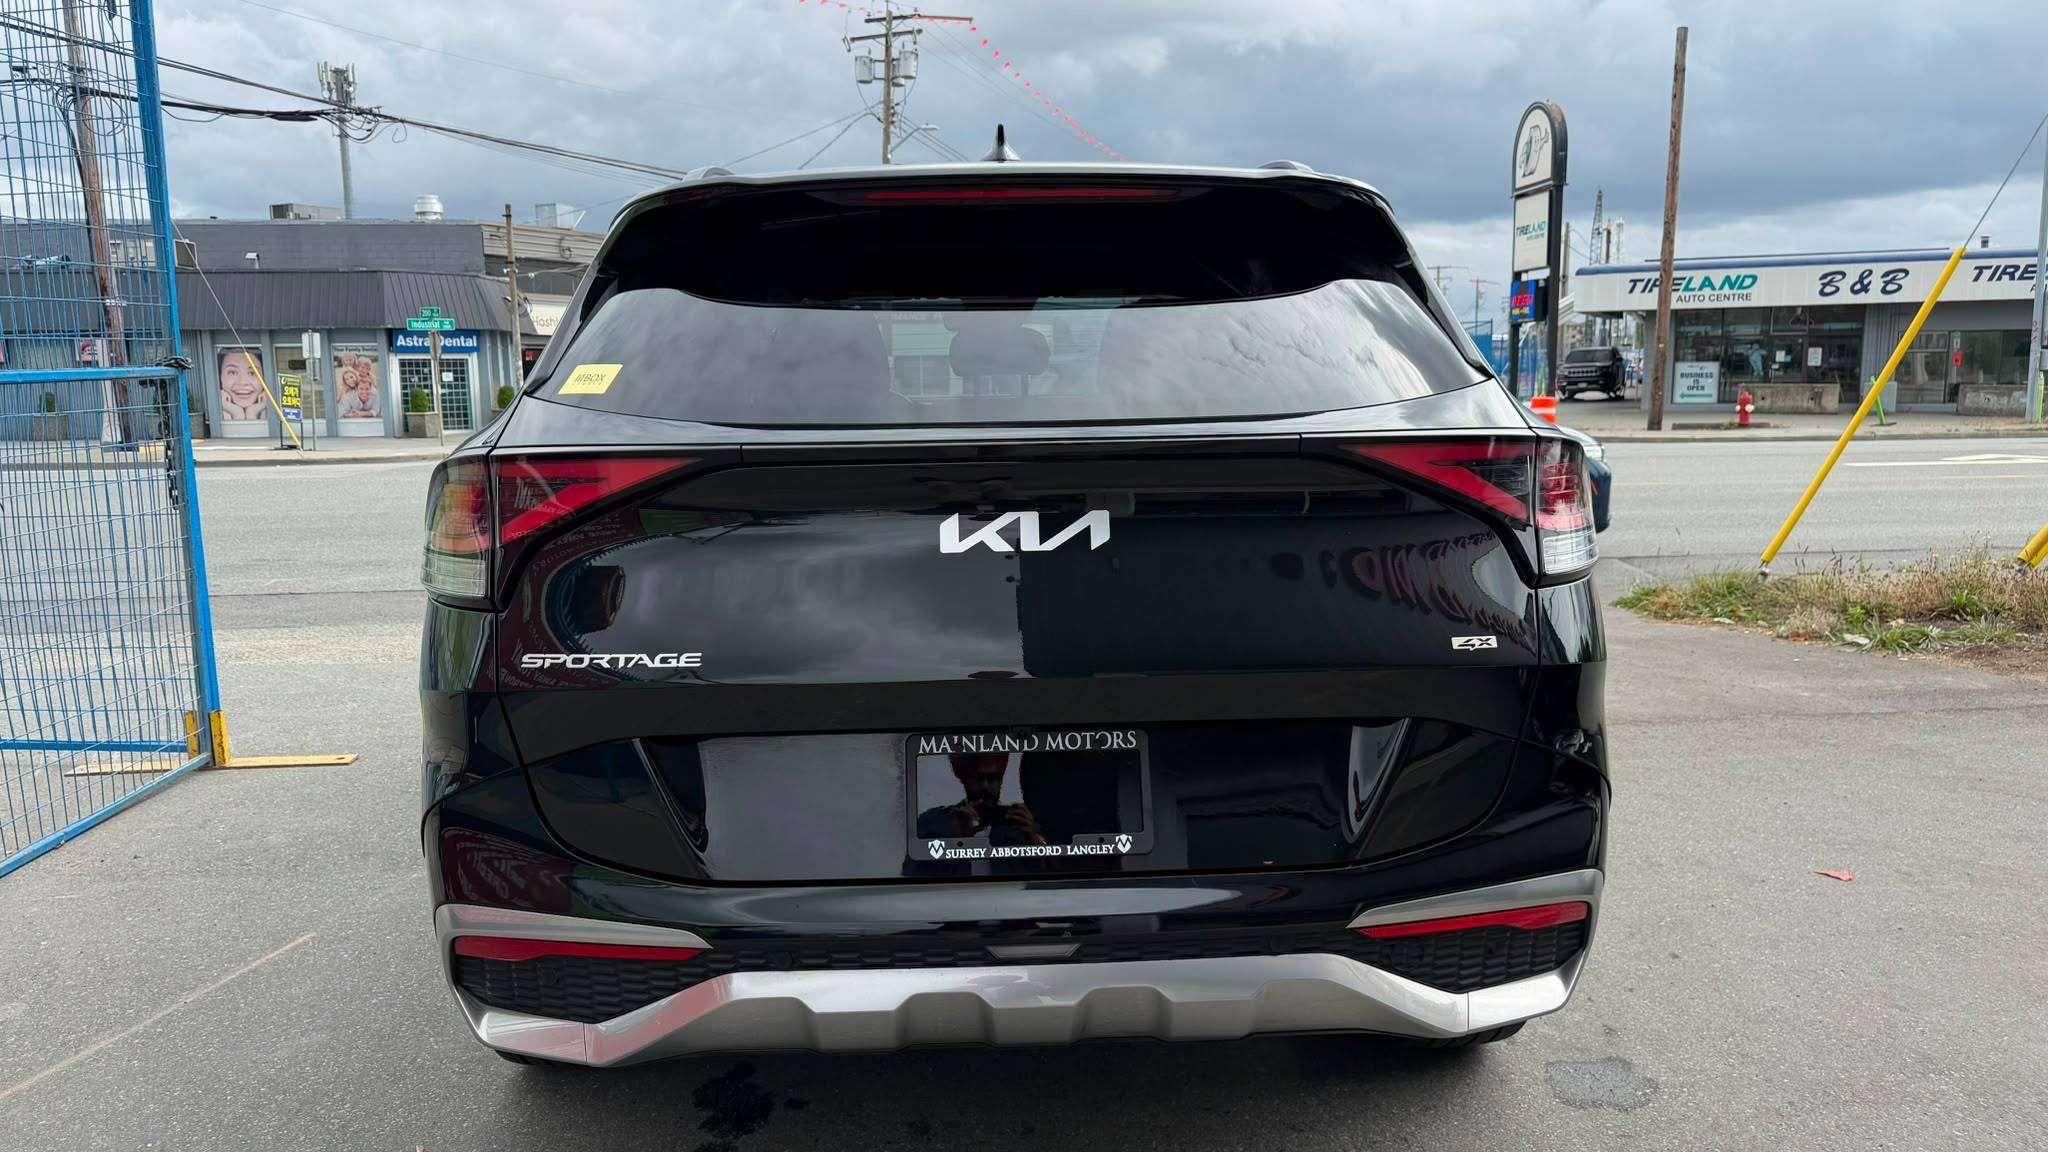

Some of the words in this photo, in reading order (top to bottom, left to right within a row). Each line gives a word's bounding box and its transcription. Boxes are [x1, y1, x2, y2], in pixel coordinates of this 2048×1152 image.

[1818, 270, 1847, 297] B
[1850, 269, 1873, 295] &
[1880, 268, 1910, 295] B
[1676, 294, 1705, 303] AUTO
[1708, 292, 1752, 302] CENTRE
[396, 335, 430, 347] Astra
[939, 510, 1111, 553] KIA
[521, 652, 703, 669] SPORTAGE
[918, 734, 1038, 754] MANLAND
[945, 848, 987, 859] SURREY
[990, 845, 1062, 857] ABBOTSFORD
[1066, 844, 1116, 855] LANGLEY
